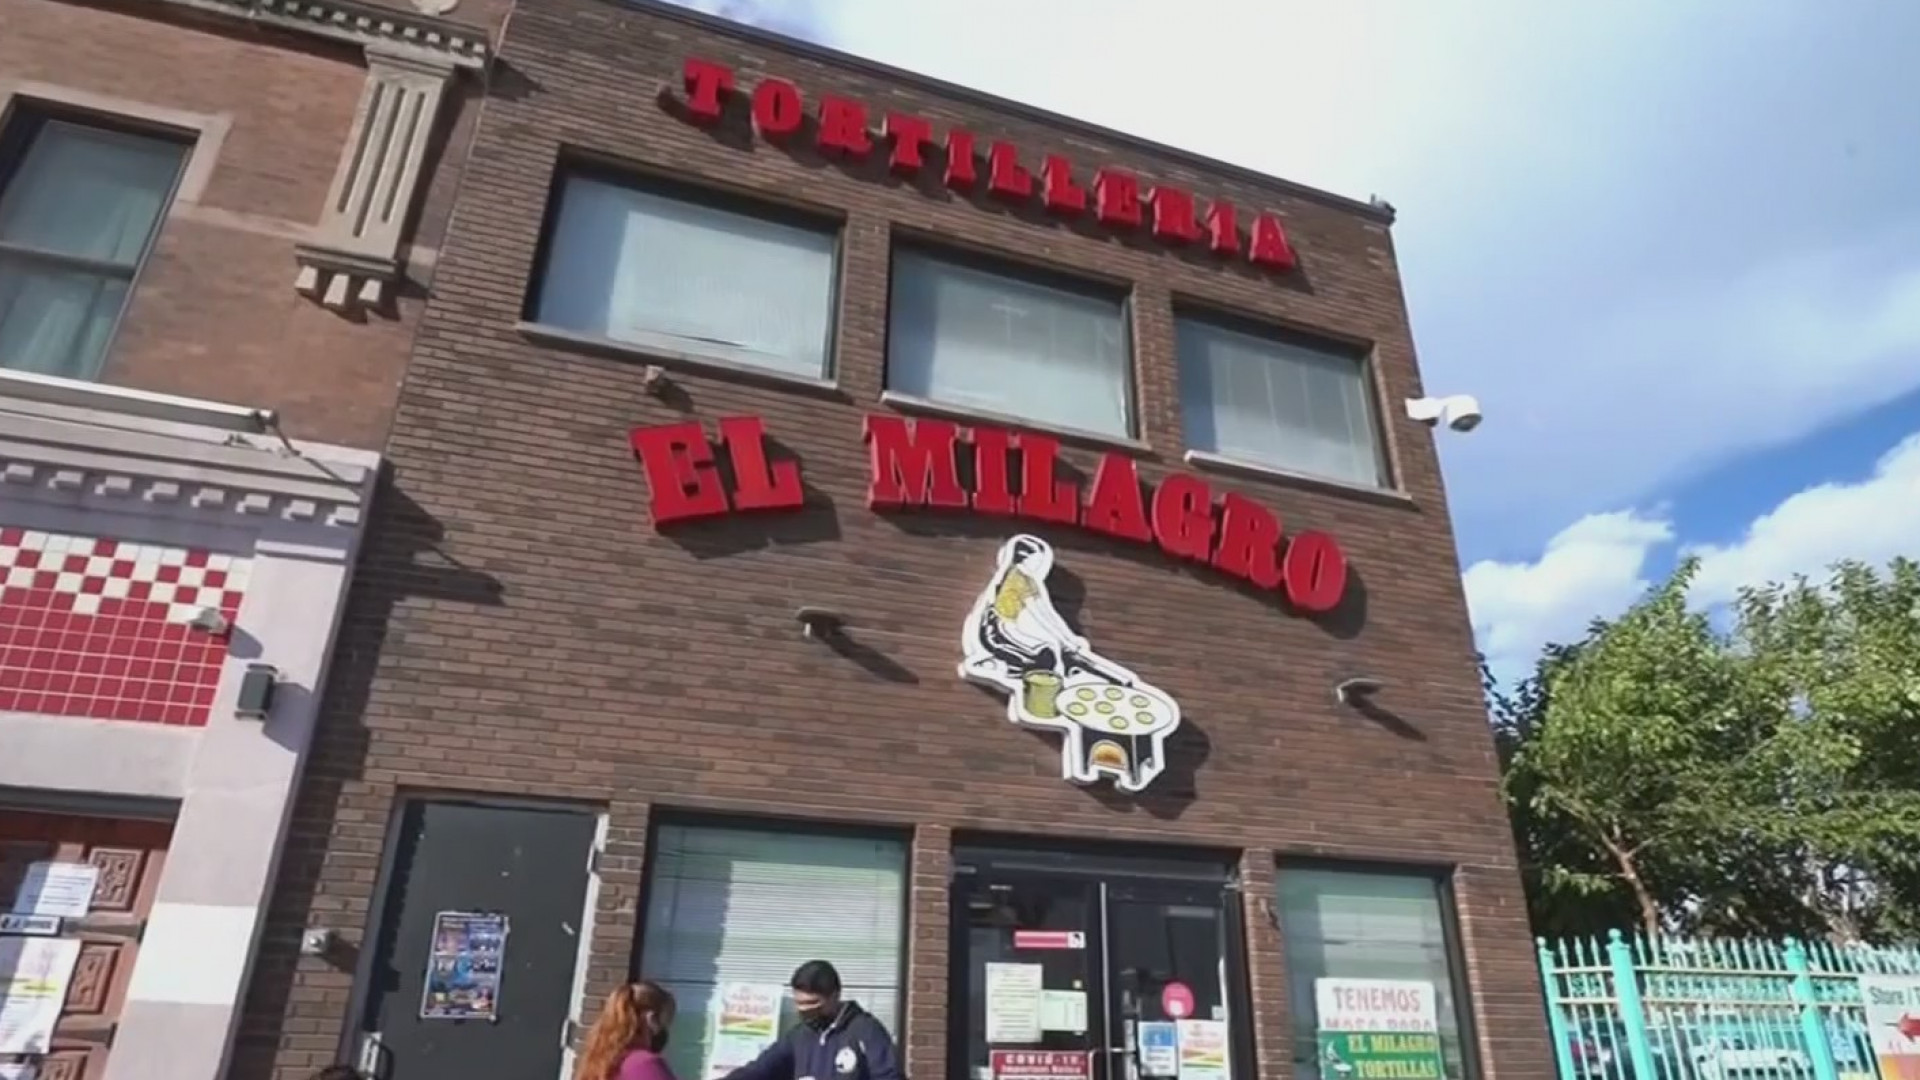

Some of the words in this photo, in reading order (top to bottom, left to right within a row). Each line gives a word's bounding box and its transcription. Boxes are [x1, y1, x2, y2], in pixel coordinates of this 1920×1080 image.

[684, 58, 1295, 269] TORTILLERIA
[631, 416, 803, 528] EL
[864, 413, 1346, 610] MILAGRO
[1333, 986, 1420, 1011] TENEMOS
[1868, 986, 1904, 1005] Store
[1348, 1034, 1368, 1053] EL
[1371, 1034, 1437, 1053] MILAGRO
[1355, 1060, 1438, 1078] TORTILLAS
